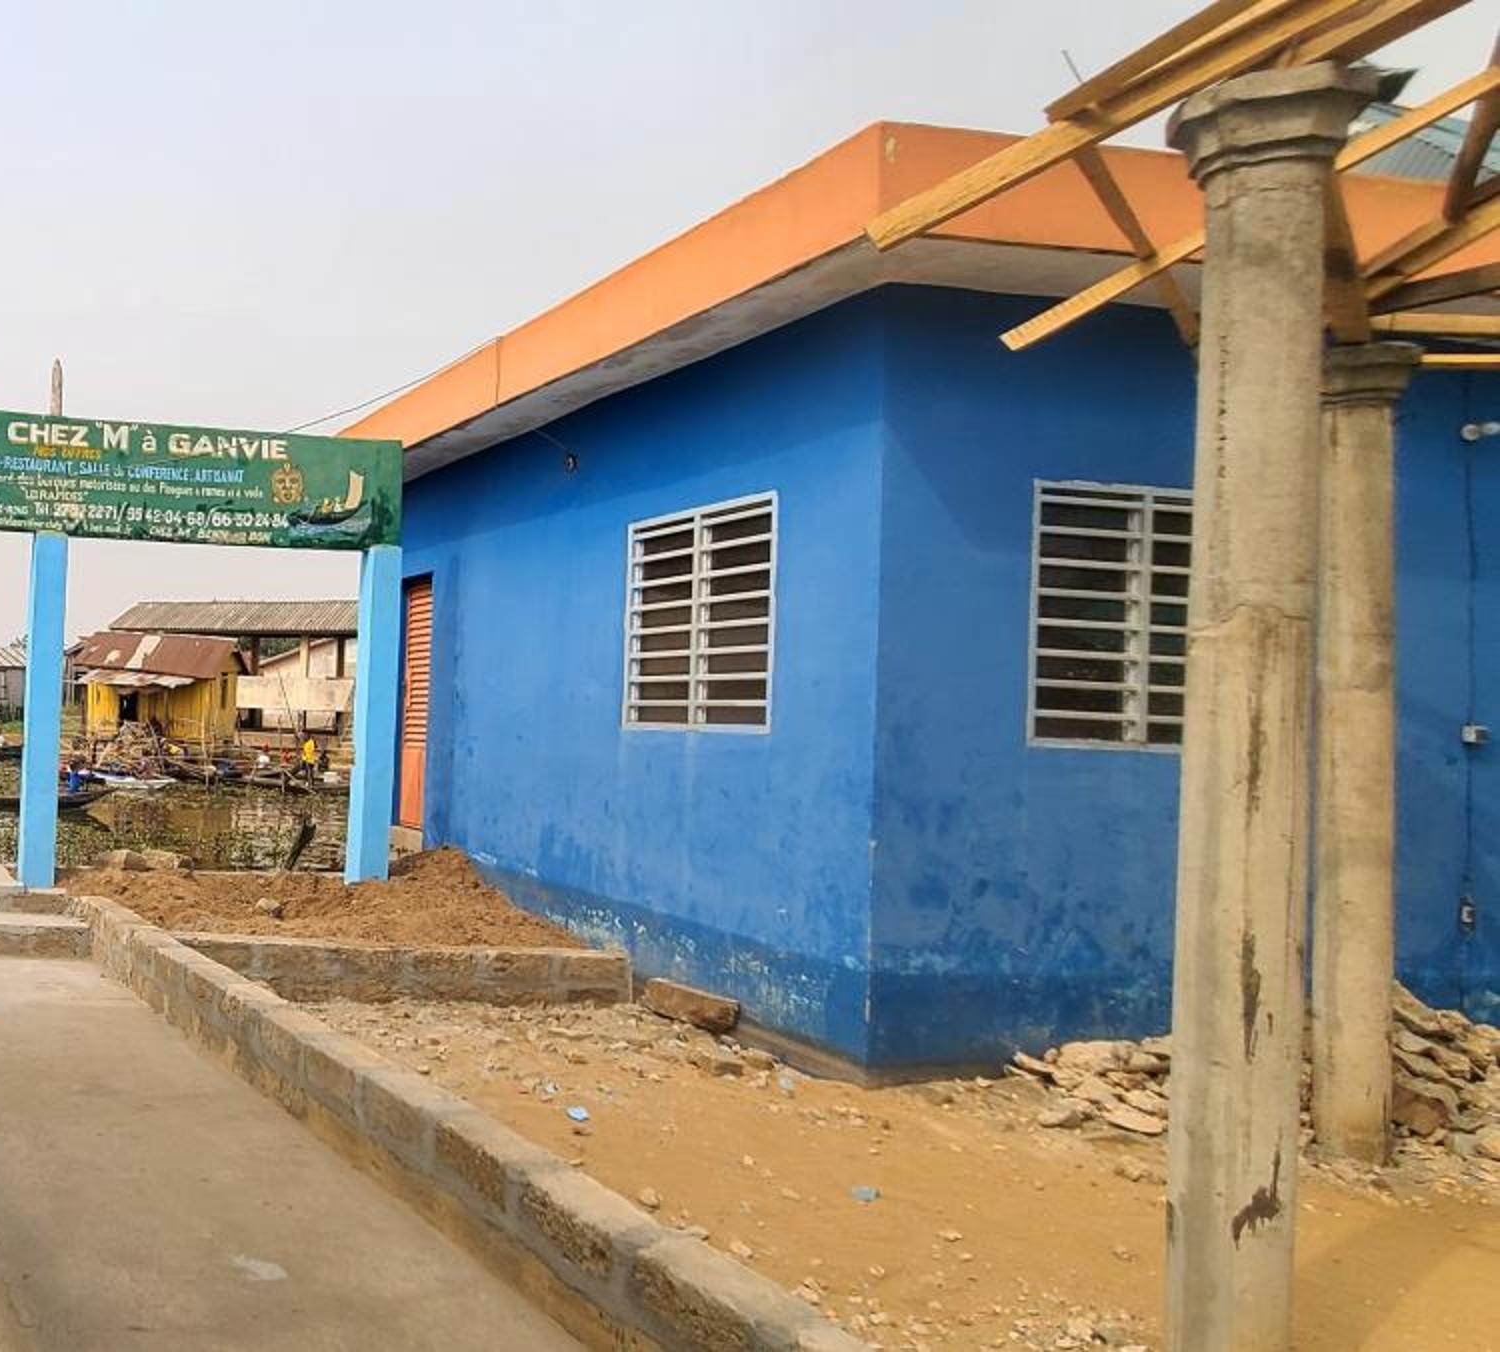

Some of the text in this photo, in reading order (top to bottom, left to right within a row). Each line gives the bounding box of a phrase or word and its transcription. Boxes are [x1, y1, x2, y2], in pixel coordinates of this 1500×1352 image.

[7, 421, 90, 447] CHEZ
[141, 430, 157, 453] à
[167, 433, 289, 460] GANVIE
[79, 461, 111, 476] SALLE
